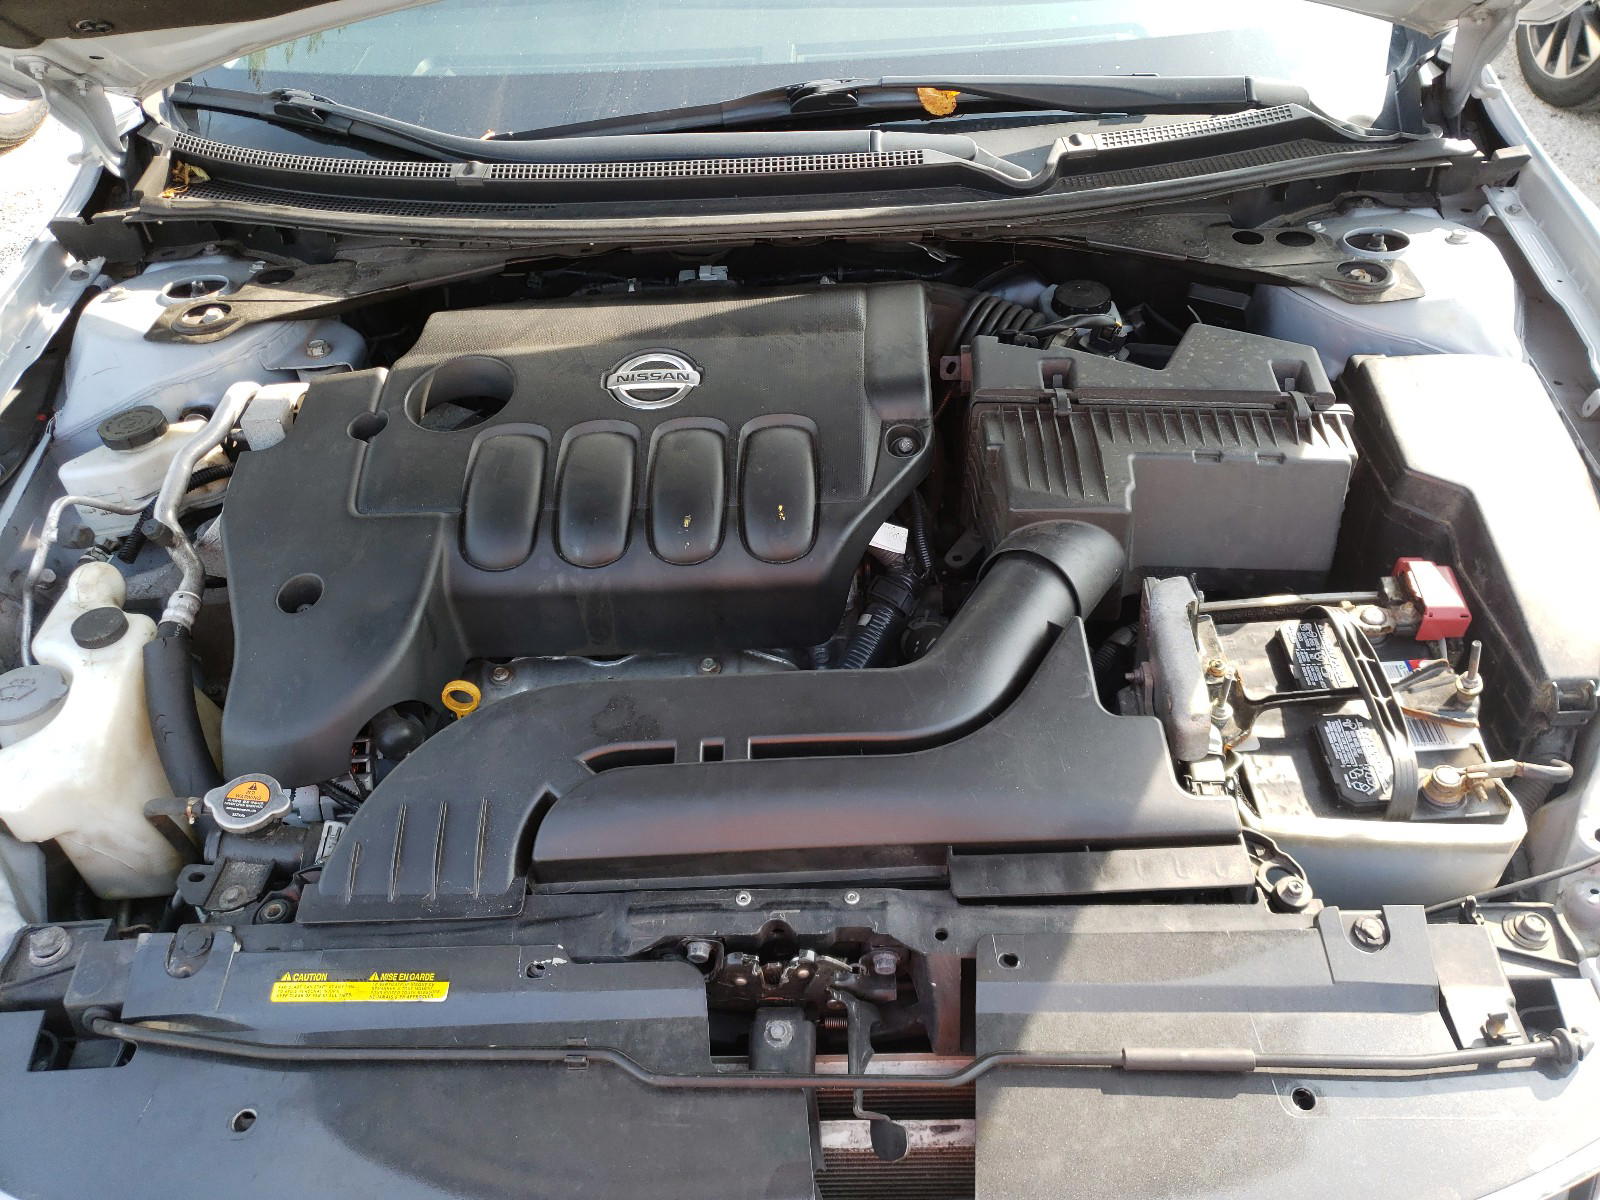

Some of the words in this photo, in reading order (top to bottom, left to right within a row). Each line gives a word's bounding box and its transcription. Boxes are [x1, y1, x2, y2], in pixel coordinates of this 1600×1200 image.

[616, 372, 690, 383] NISSAN
[293, 973, 328, 982] CAUTION
[380, 973, 398, 982] MISE
[398, 973, 409, 982] EN
[409, 973, 435, 982] GARDE
